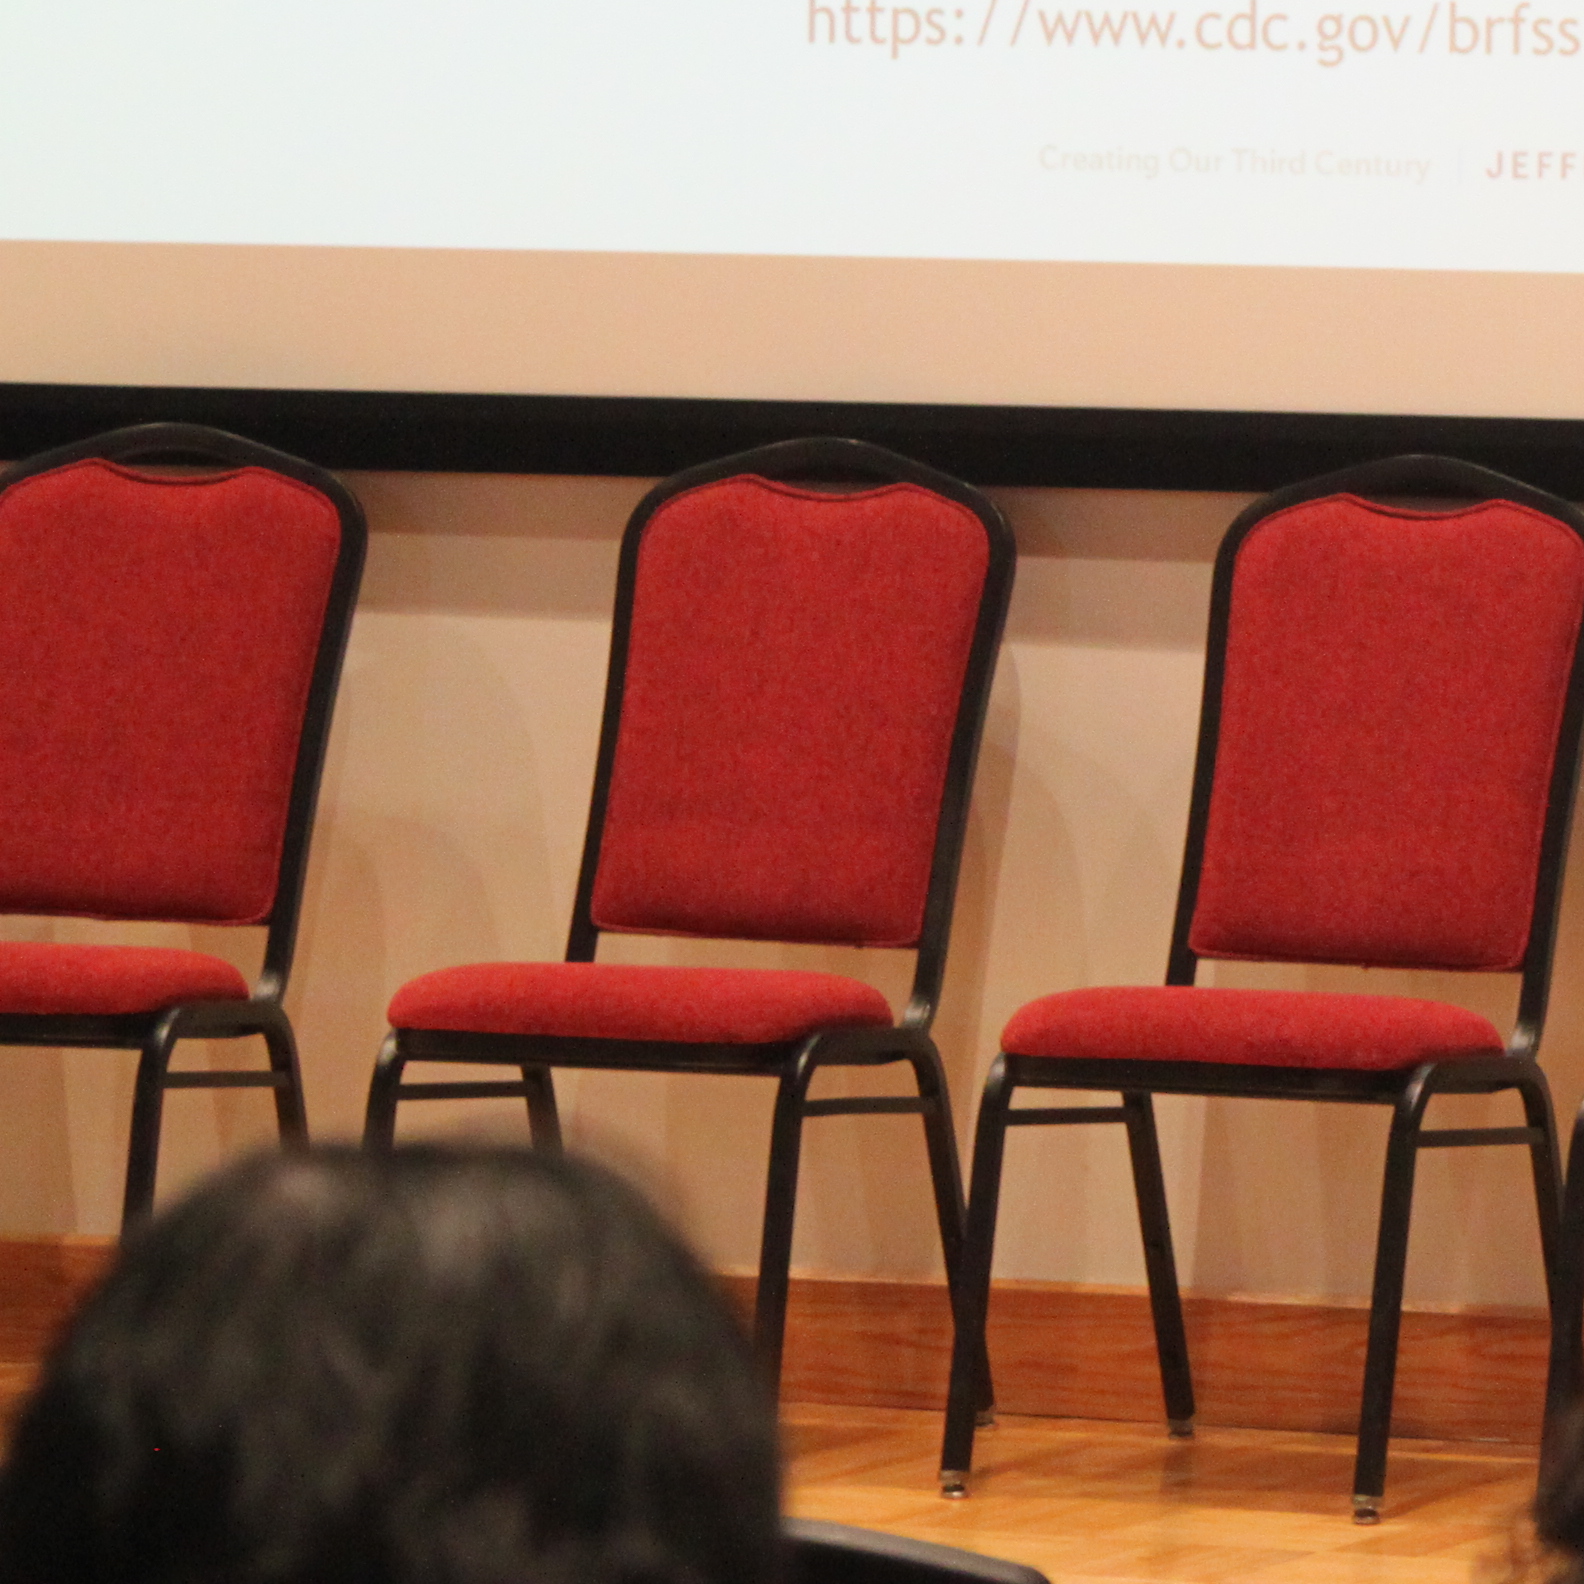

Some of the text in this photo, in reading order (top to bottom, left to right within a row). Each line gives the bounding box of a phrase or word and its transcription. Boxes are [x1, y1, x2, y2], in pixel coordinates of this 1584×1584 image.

[1037, 144, 1431, 184] Creating Our Third Century
